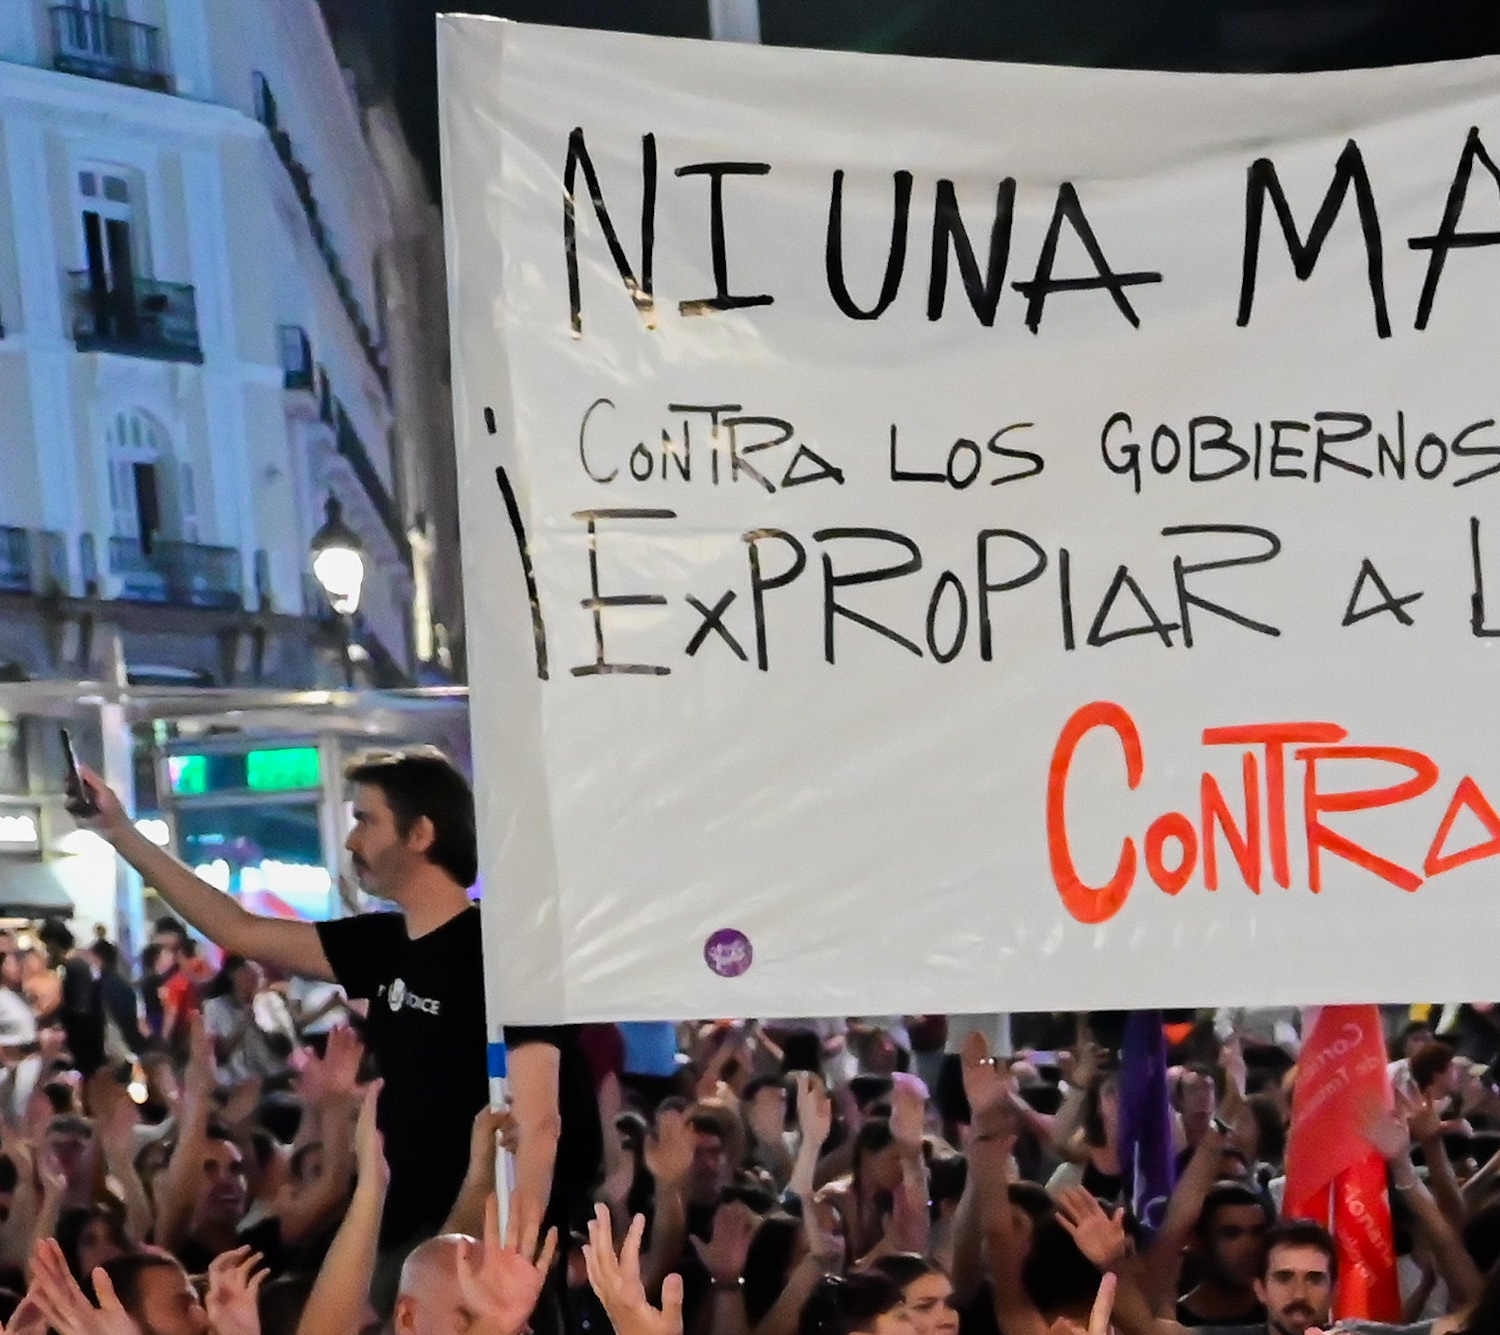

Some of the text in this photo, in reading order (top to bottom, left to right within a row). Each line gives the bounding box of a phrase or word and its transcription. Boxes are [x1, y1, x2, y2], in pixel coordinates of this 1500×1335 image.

[562, 127, 774, 340] NI
[825, 169, 1164, 336] UNA
[890, 422, 1045, 490] LOS
[1342, 559, 1424, 628] A
